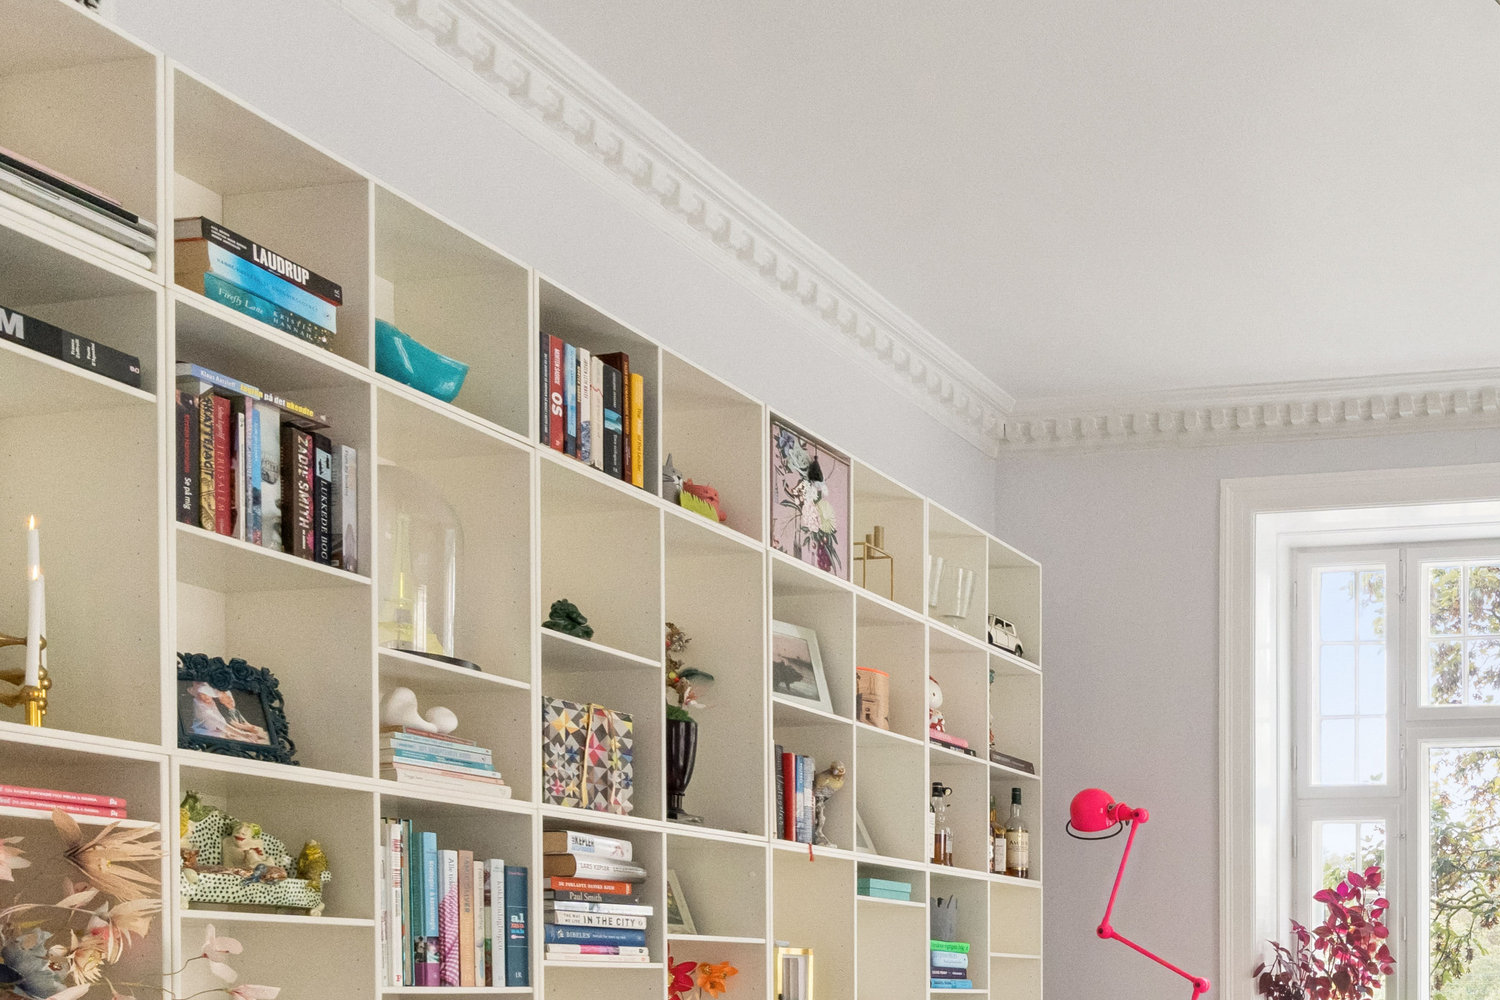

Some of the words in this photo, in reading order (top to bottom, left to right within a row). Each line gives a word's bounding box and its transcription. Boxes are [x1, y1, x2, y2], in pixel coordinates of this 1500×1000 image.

[252, 243, 310, 286] LAUDRUP
[218, 287, 242, 304] Firefly
[245, 299, 264, 314] Lane
[200, 369, 215, 381] Klaus
[264, 392, 273, 402] på
[274, 396, 286, 407] det
[286, 401, 314, 417] ukendte
[551, 392, 563, 417] OS
[297, 435, 309, 478] ZADIE
[183, 486, 193, 495] på
[184, 477, 192, 485] Se
[217, 445, 225, 512] JERUSALEM
[183, 496, 193, 510] mig
[298, 481, 310, 529] SMITH
[320, 480, 328, 534] LUKKEDE
[320, 536, 328, 560] BOG
[569, 891, 583, 901] Paul
[584, 893, 602, 902] Smith
[583, 916, 592, 924] IN
[596, 916, 613, 926] THE
[616, 917, 635, 927] CITY
[566, 931, 591, 939] BIBELEN
